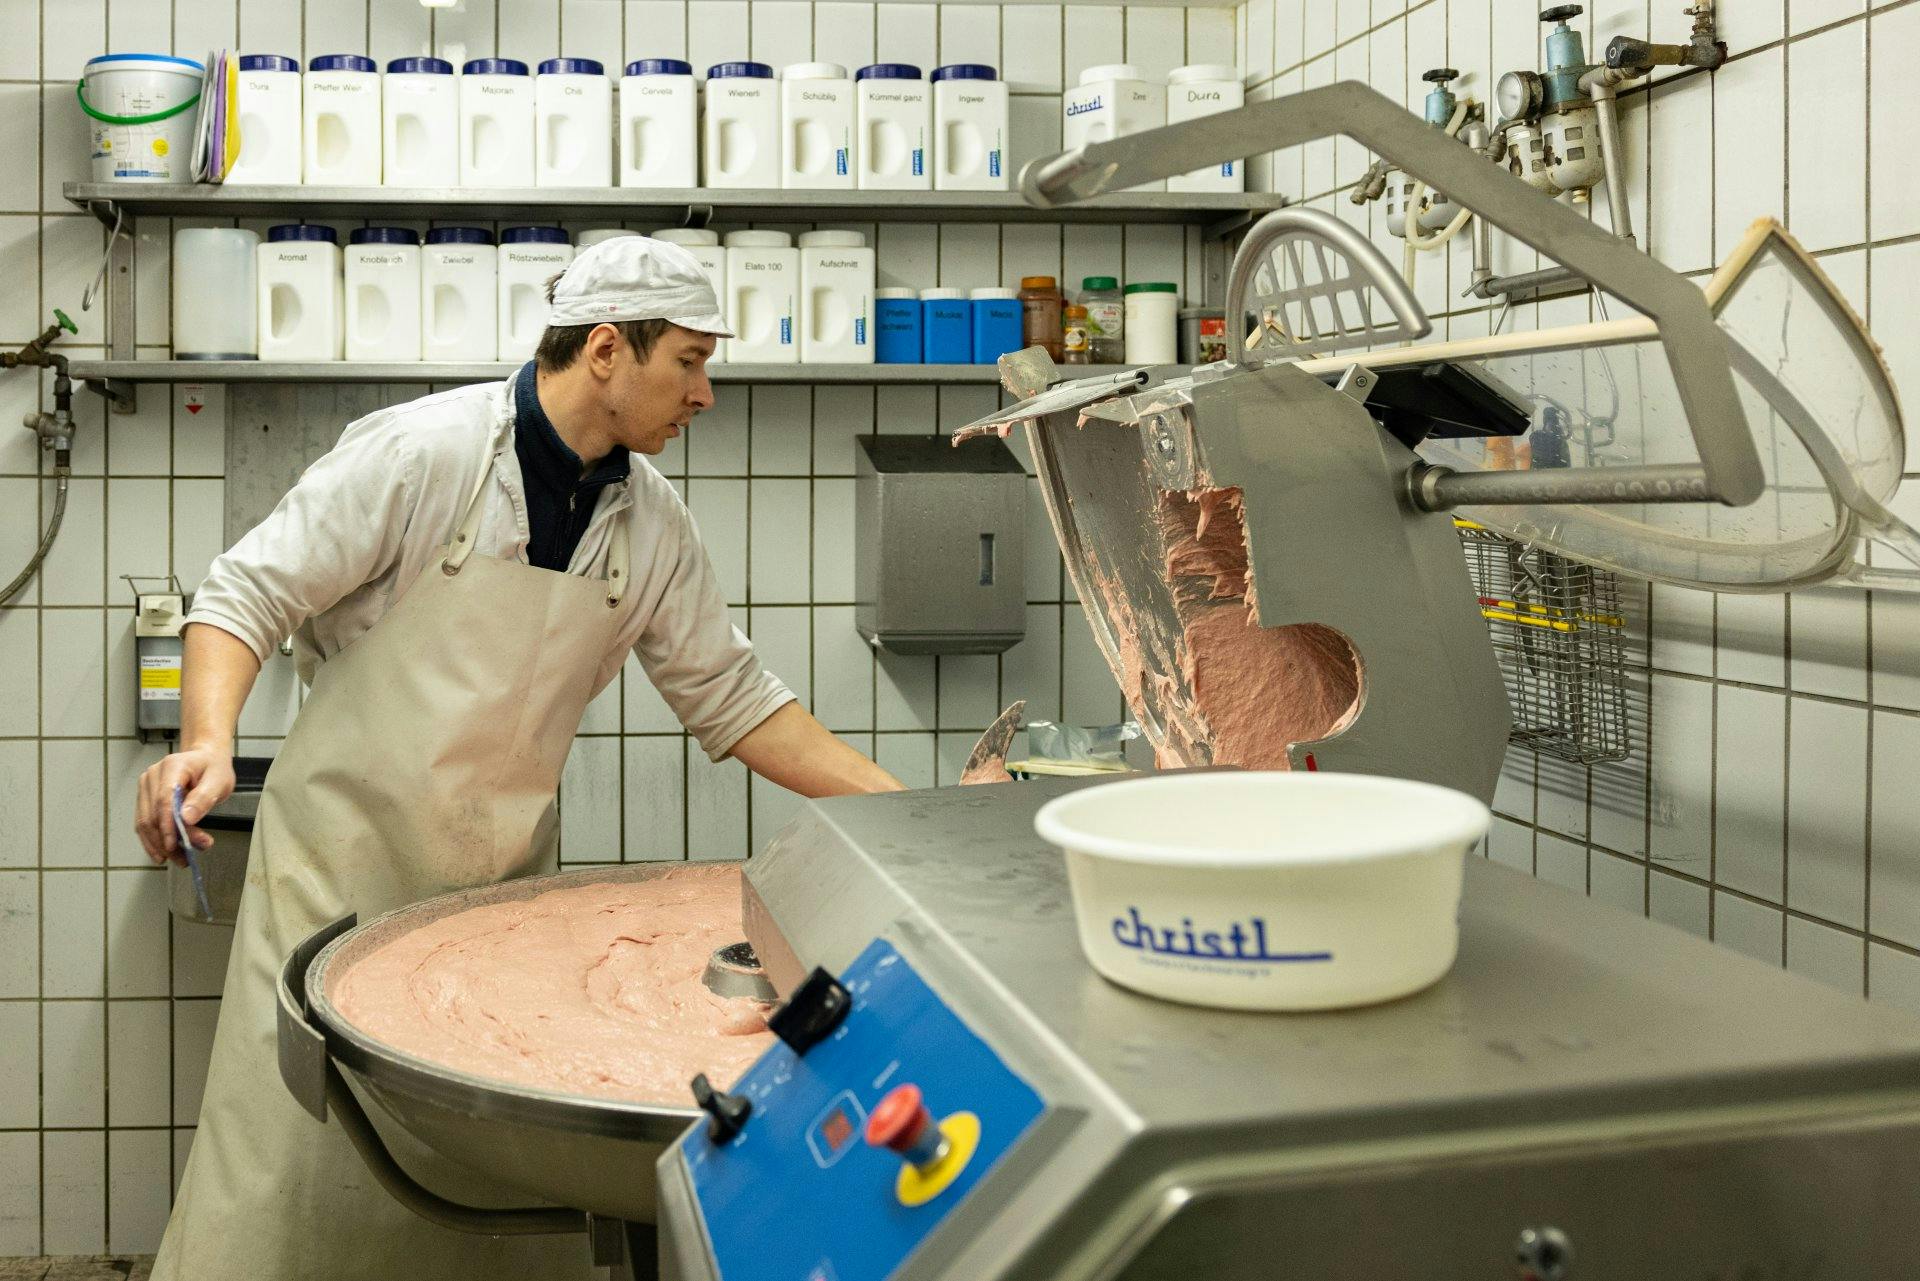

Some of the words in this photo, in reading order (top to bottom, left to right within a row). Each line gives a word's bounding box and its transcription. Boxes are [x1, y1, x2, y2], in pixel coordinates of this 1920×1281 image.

[482, 86, 514, 96] Majoran
[903, 95, 922, 103] ganz
[958, 94, 985, 104] Ingwer
[1187, 90, 1221, 103] Dura
[1066, 95, 1104, 117] christl
[278, 253, 307, 262] Aromat
[442, 255, 474, 265] Zwiebel
[768, 262, 782, 272] 100
[819, 260, 858, 269] Aufschnitt
[1112, 906, 1332, 962] christl
